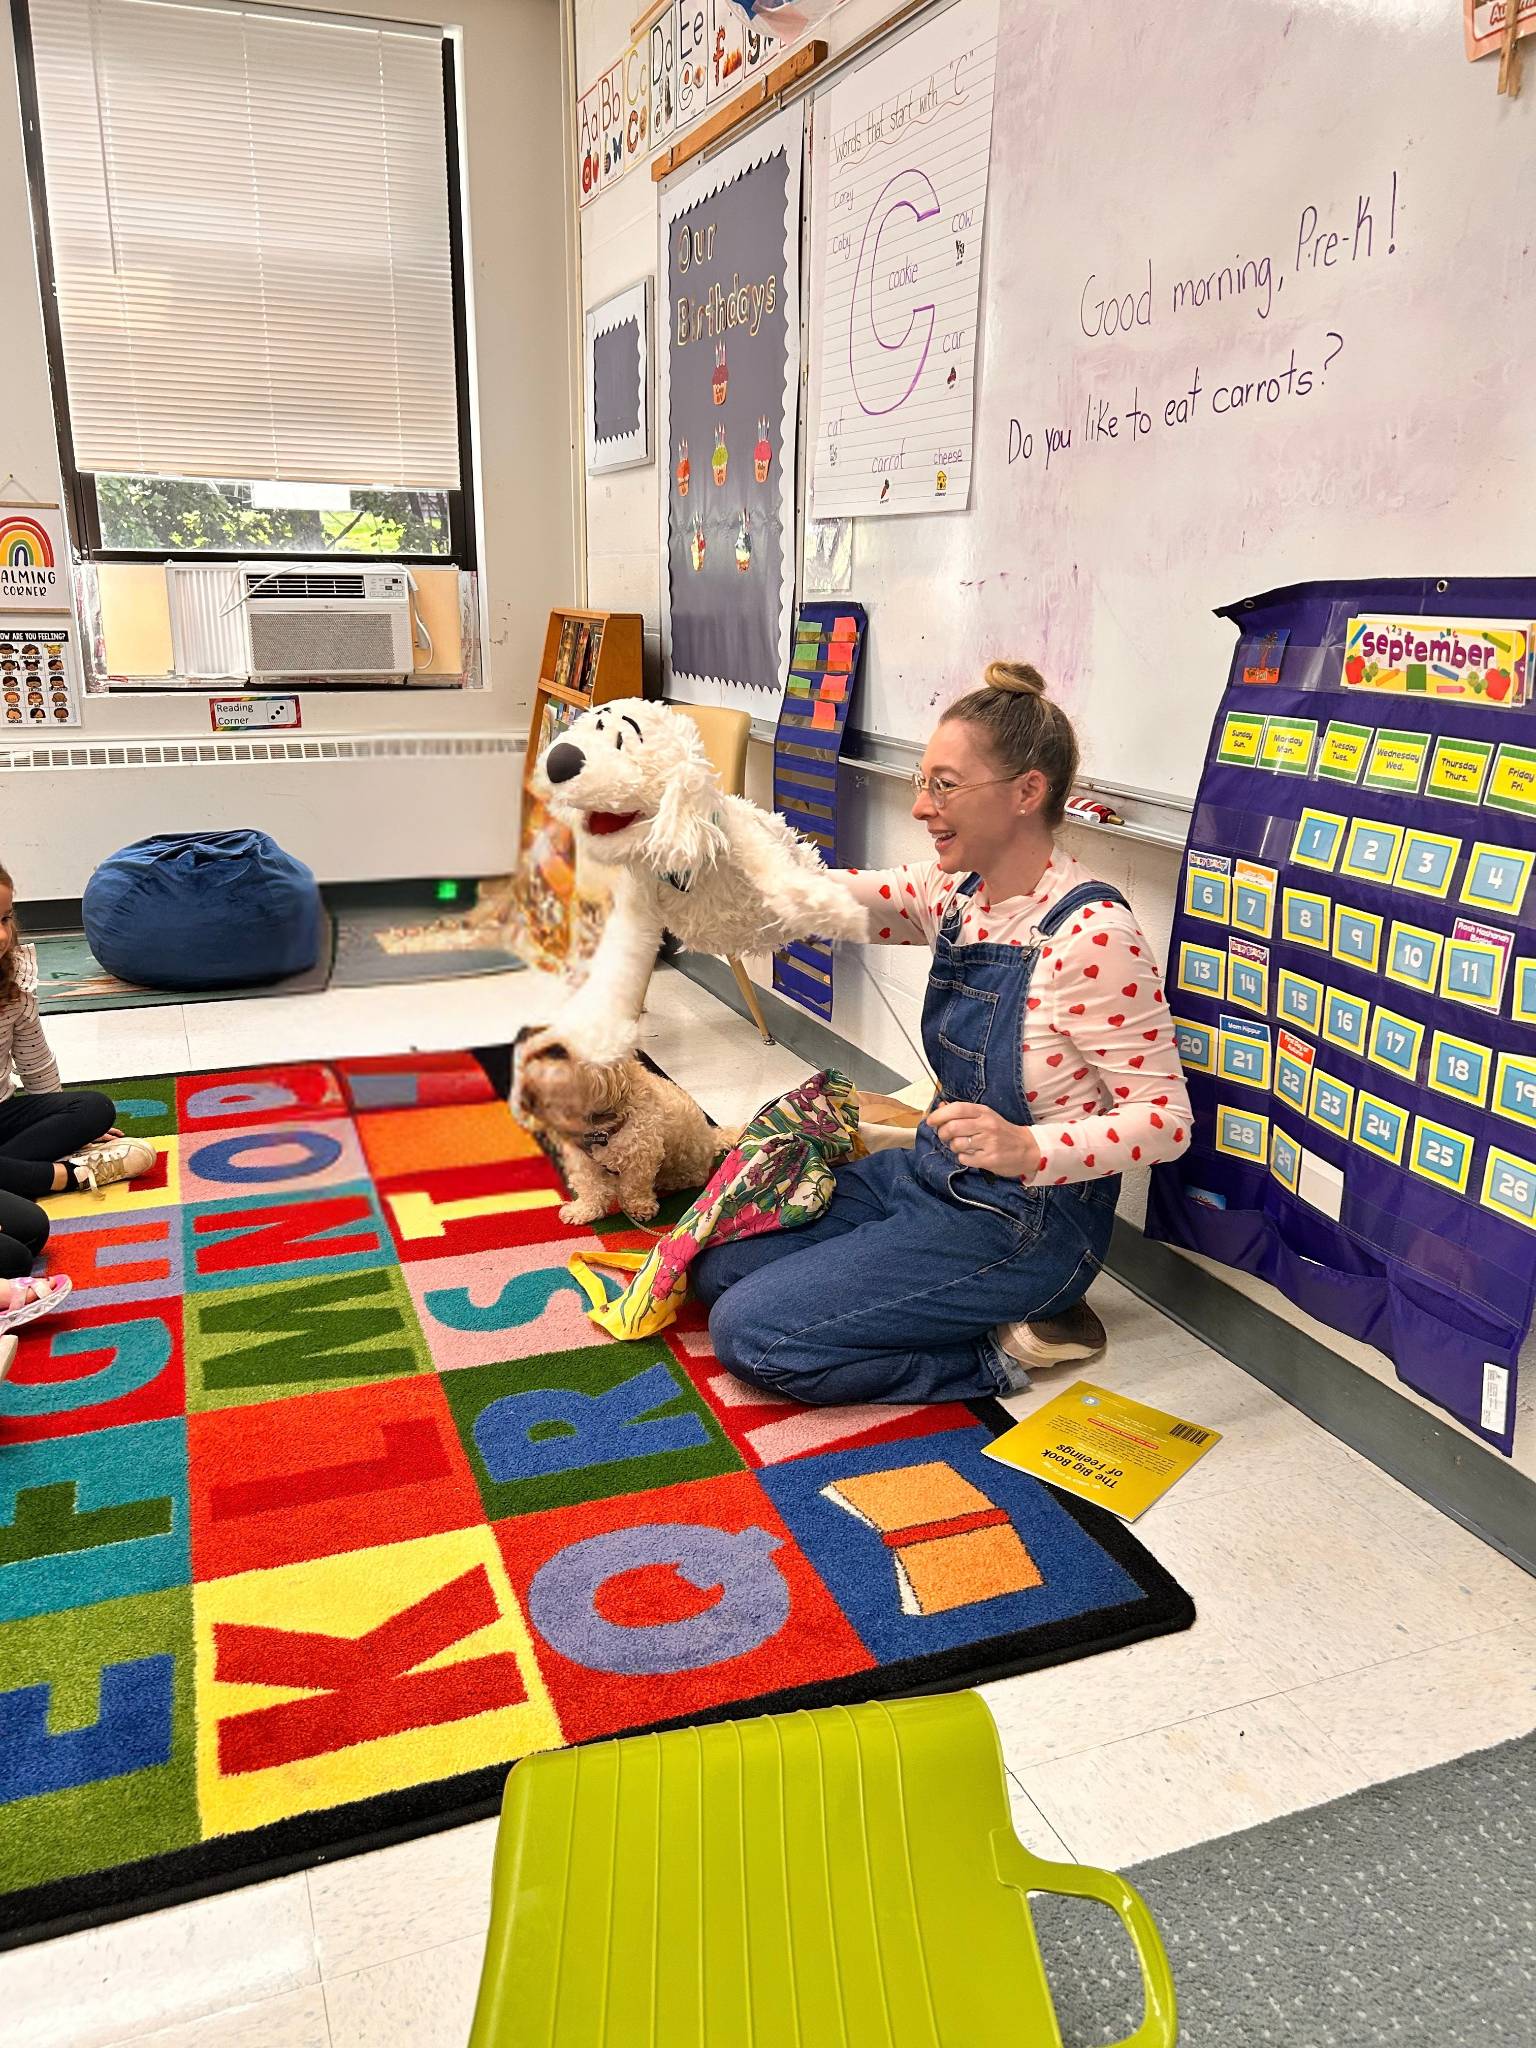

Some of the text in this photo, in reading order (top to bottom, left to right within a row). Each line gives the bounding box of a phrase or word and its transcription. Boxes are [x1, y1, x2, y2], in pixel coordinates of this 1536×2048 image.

[652, 9, 674, 86] Dd
[626, 50, 647, 106] Cc
[602, 72, 620, 131] Bb
[867, 103, 884, 145] that
[890, 90, 912, 130] start
[919, 75, 938, 114] with
[580, 101, 599, 153] Aa
[951, 209, 974, 233] cow
[678, 223, 717, 274] Our
[888, 256, 919, 291] cookie
[1080, 259, 1152, 337] Good
[1173, 254, 1285, 319] morning,
[677, 273, 776, 346] Birthdays
[943, 331, 966, 354] car
[1008, 332, 1344, 470] Do you like to eat carrots?
[827, 406, 845, 438] cat
[871, 438, 906, 474] carrot
[933, 447, 963, 466] cheese
[0, 569, 56, 585] ALMING
[3, 585, 47, 597] CORNER
[0, 631, 66, 641] OW ARE YOU FEELING?
[1362, 631, 1495, 670] september
[216, 702, 254, 713] Reading
[218, 715, 250, 726] Corner
[1231, 729, 1253, 741] Sunday
[1233, 740, 1246, 748] Sun.
[1273, 734, 1304, 747] Monday
[1331, 739, 1358, 754] Tuesday
[1377, 747, 1420, 763] Wednesday
[1385, 761, 1405, 771] Wed.
[1441, 757, 1478, 774] Thursday
[1444, 770, 1469, 782] Thurs.
[1507, 767, 1535, 783] Friday
[1511, 781, 1525, 792] Fri.
[1312, 829, 1322, 849] 1
[1366, 840, 1378, 861] 2
[1418, 851, 1433, 874] 3
[1487, 867, 1502, 890] 4
[1202, 886, 1213, 905] 6
[1247, 897, 1256, 916] 7
[1299, 909, 1312, 928] 8
[1352, 927, 1363, 950] 9
[1403, 943, 1424, 968] 10
[1193, 960, 1211, 980] 13
[1461, 960, 1479, 985] 11
[1239, 972, 1257, 994] 14
[1290, 989, 1309, 1012] 15
[1337, 1009, 1353, 1032] 16
[1180, 1035, 1203, 1056] 20
[1386, 1030, 1406, 1054] 17
[1232, 1049, 1254, 1071] 21
[1447, 1056, 1470, 1081] 18
[1281, 1067, 1299, 1094] 22
[1319, 1090, 1342, 1115] 23
[1515, 1080, 1536, 1107] 19
[1228, 1123, 1256, 1145] 28
[1366, 1115, 1391, 1141] 24
[1277, 1146, 1292, 1172] 29
[1424, 1142, 1455, 1168] 25
[1498, 1173, 1529, 1203] 26
[193, 1194, 381, 1275] N
[471, 1361, 713, 1485] R
[208, 1414, 458, 1524] L
[1041, 1449, 1072, 1467] Book
[1056, 1444, 1107, 1471] Feelings
[1072, 1462, 1094, 1477] Big
[1095, 1473, 1119, 1489] The
[1105, 1467, 1124, 1477] of
[526, 1521, 792, 1676] Q
[210, 1562, 529, 1777] K
